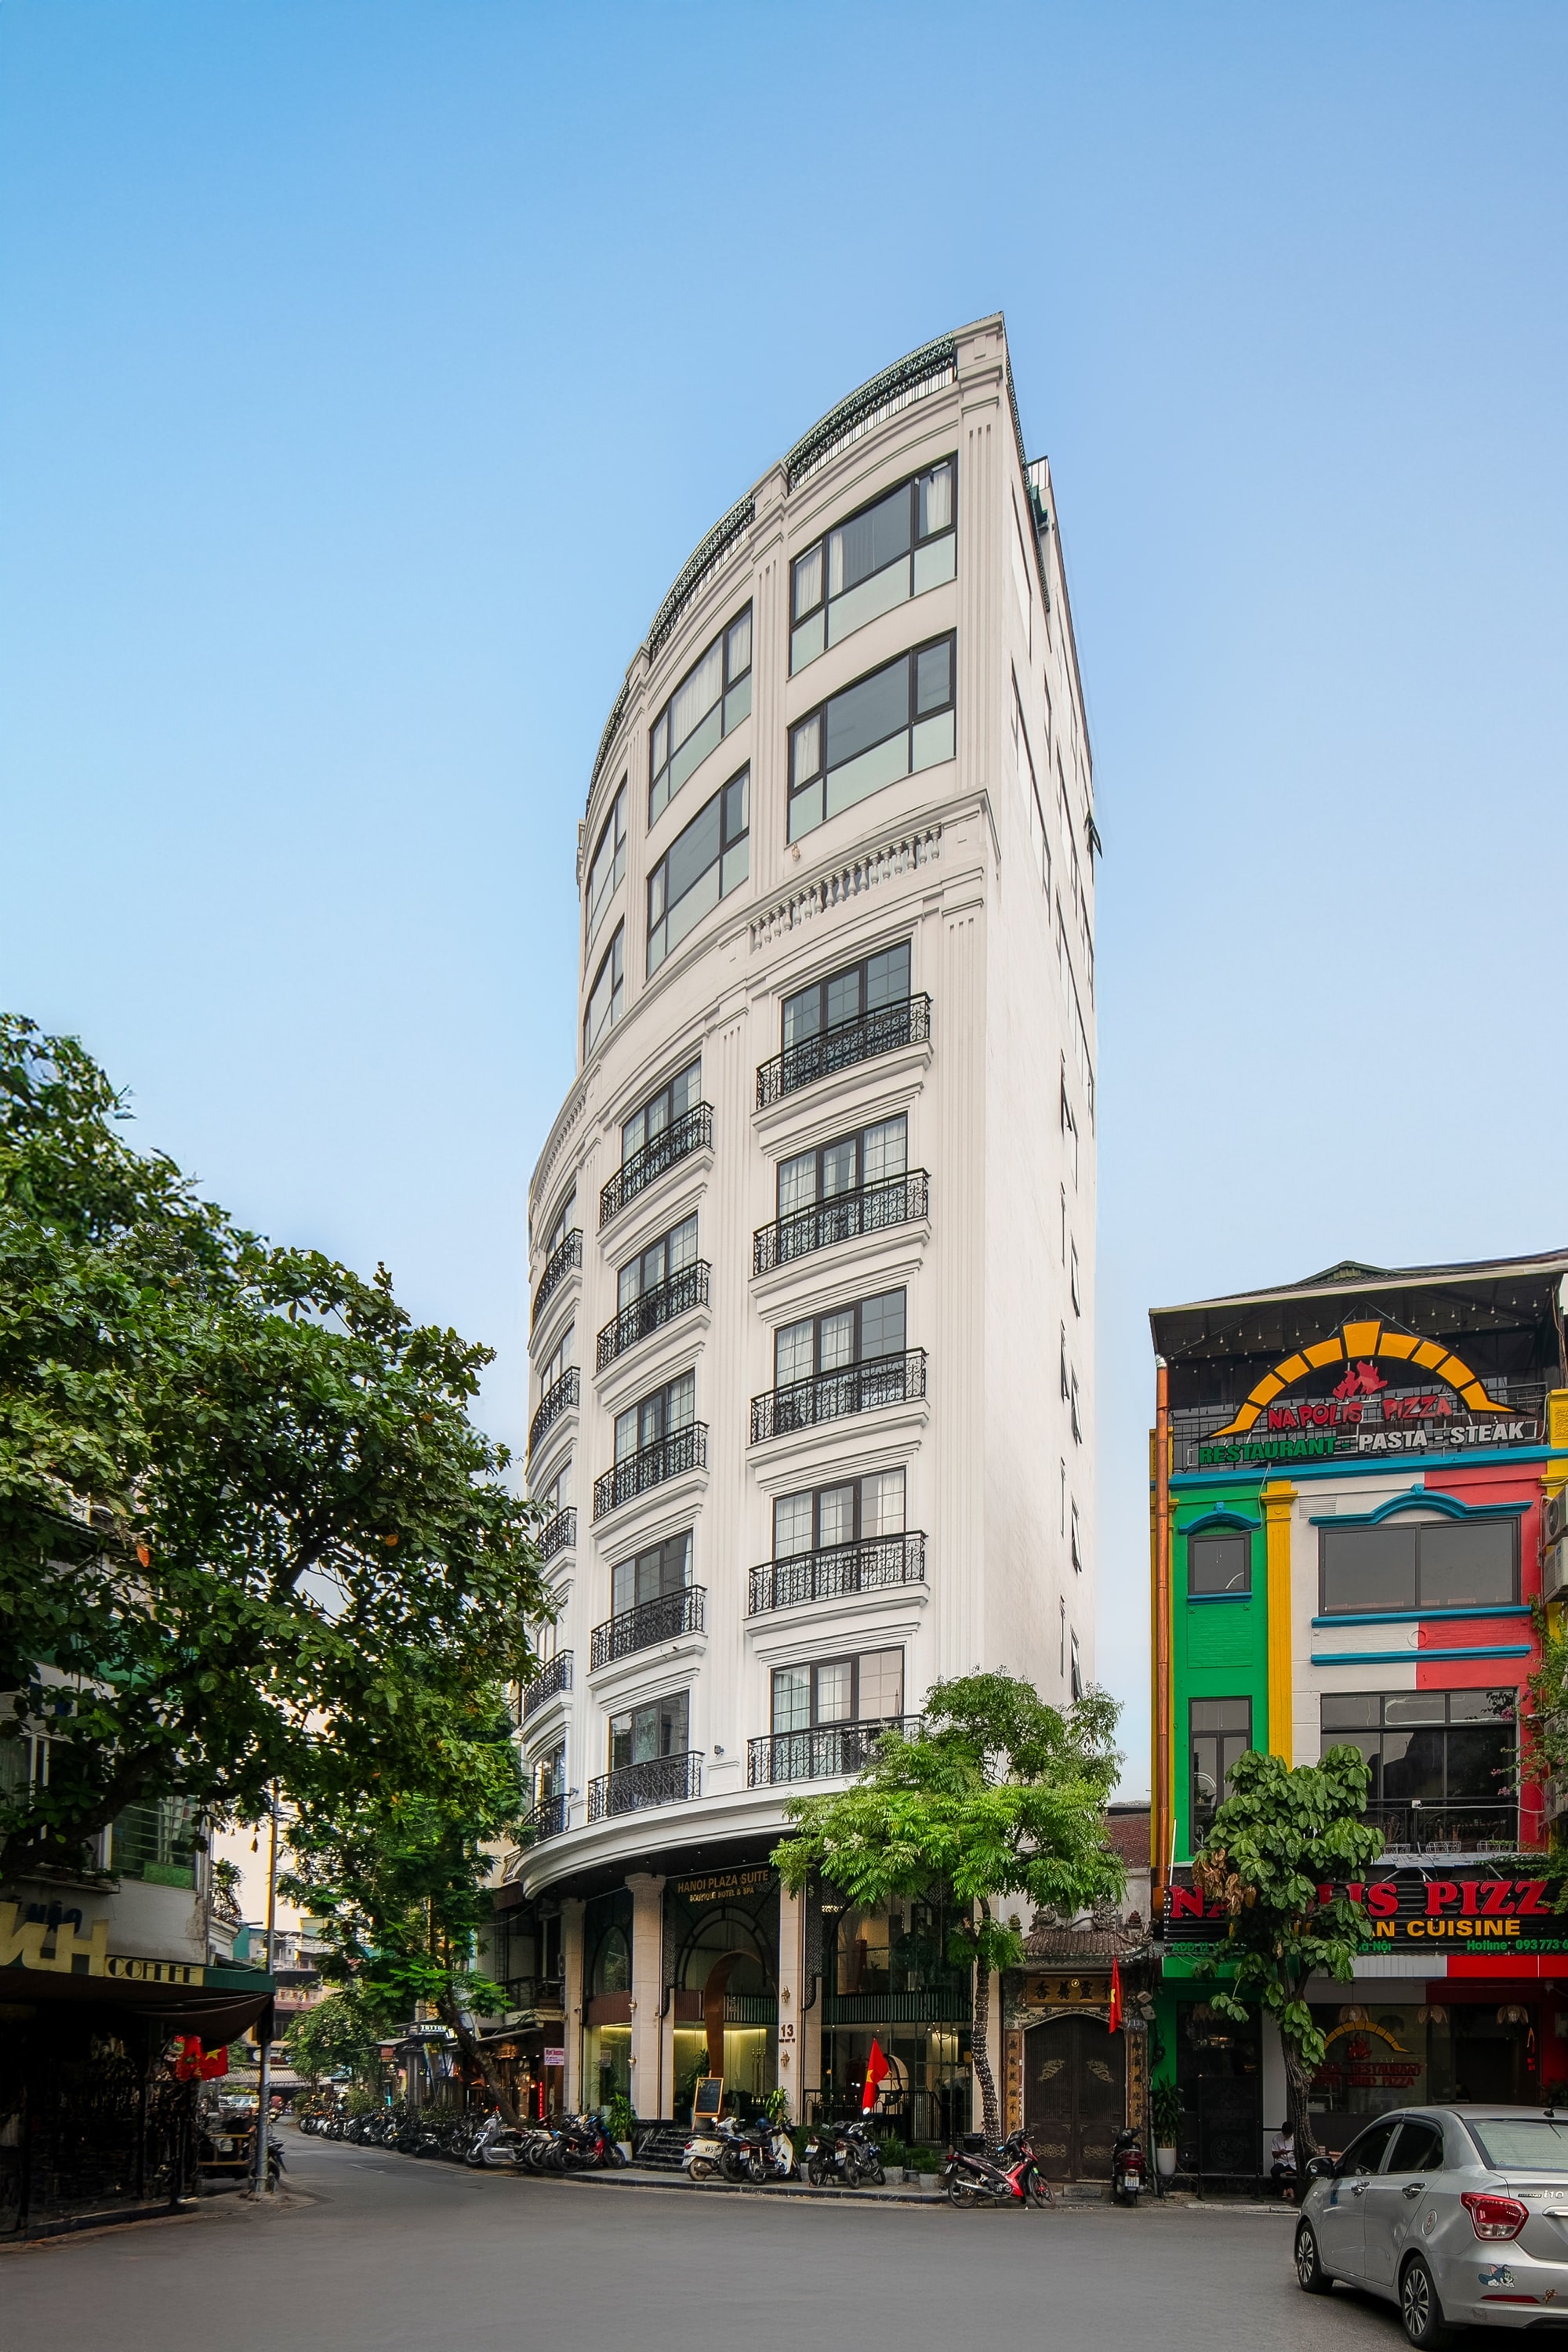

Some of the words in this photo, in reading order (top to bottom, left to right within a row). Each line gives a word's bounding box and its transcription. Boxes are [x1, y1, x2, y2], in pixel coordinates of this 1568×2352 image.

[1381, 1396, 1452, 1421] PIZZA
[1199, 1437, 1338, 1465] RESTAURANT
[1359, 1430, 1428, 1451] PASTA
[1450, 1422, 1526, 1445] STEAK
[677, 1879, 706, 1893] HANOI
[708, 1875, 738, 1889] PLAZA
[741, 1870, 769, 1884] SUITE
[718, 1889, 735, 1898] HOTEL
[1424, 1881, 1552, 1915] PIZZ
[1406, 1919, 1521, 1936] CUISINE
[108, 1958, 198, 1986] COFFEE
[781, 2024, 794, 2038] 13
[1382, 2076, 1415, 2086] PIZZA
[1544, 2190, 1564, 2199] i10
